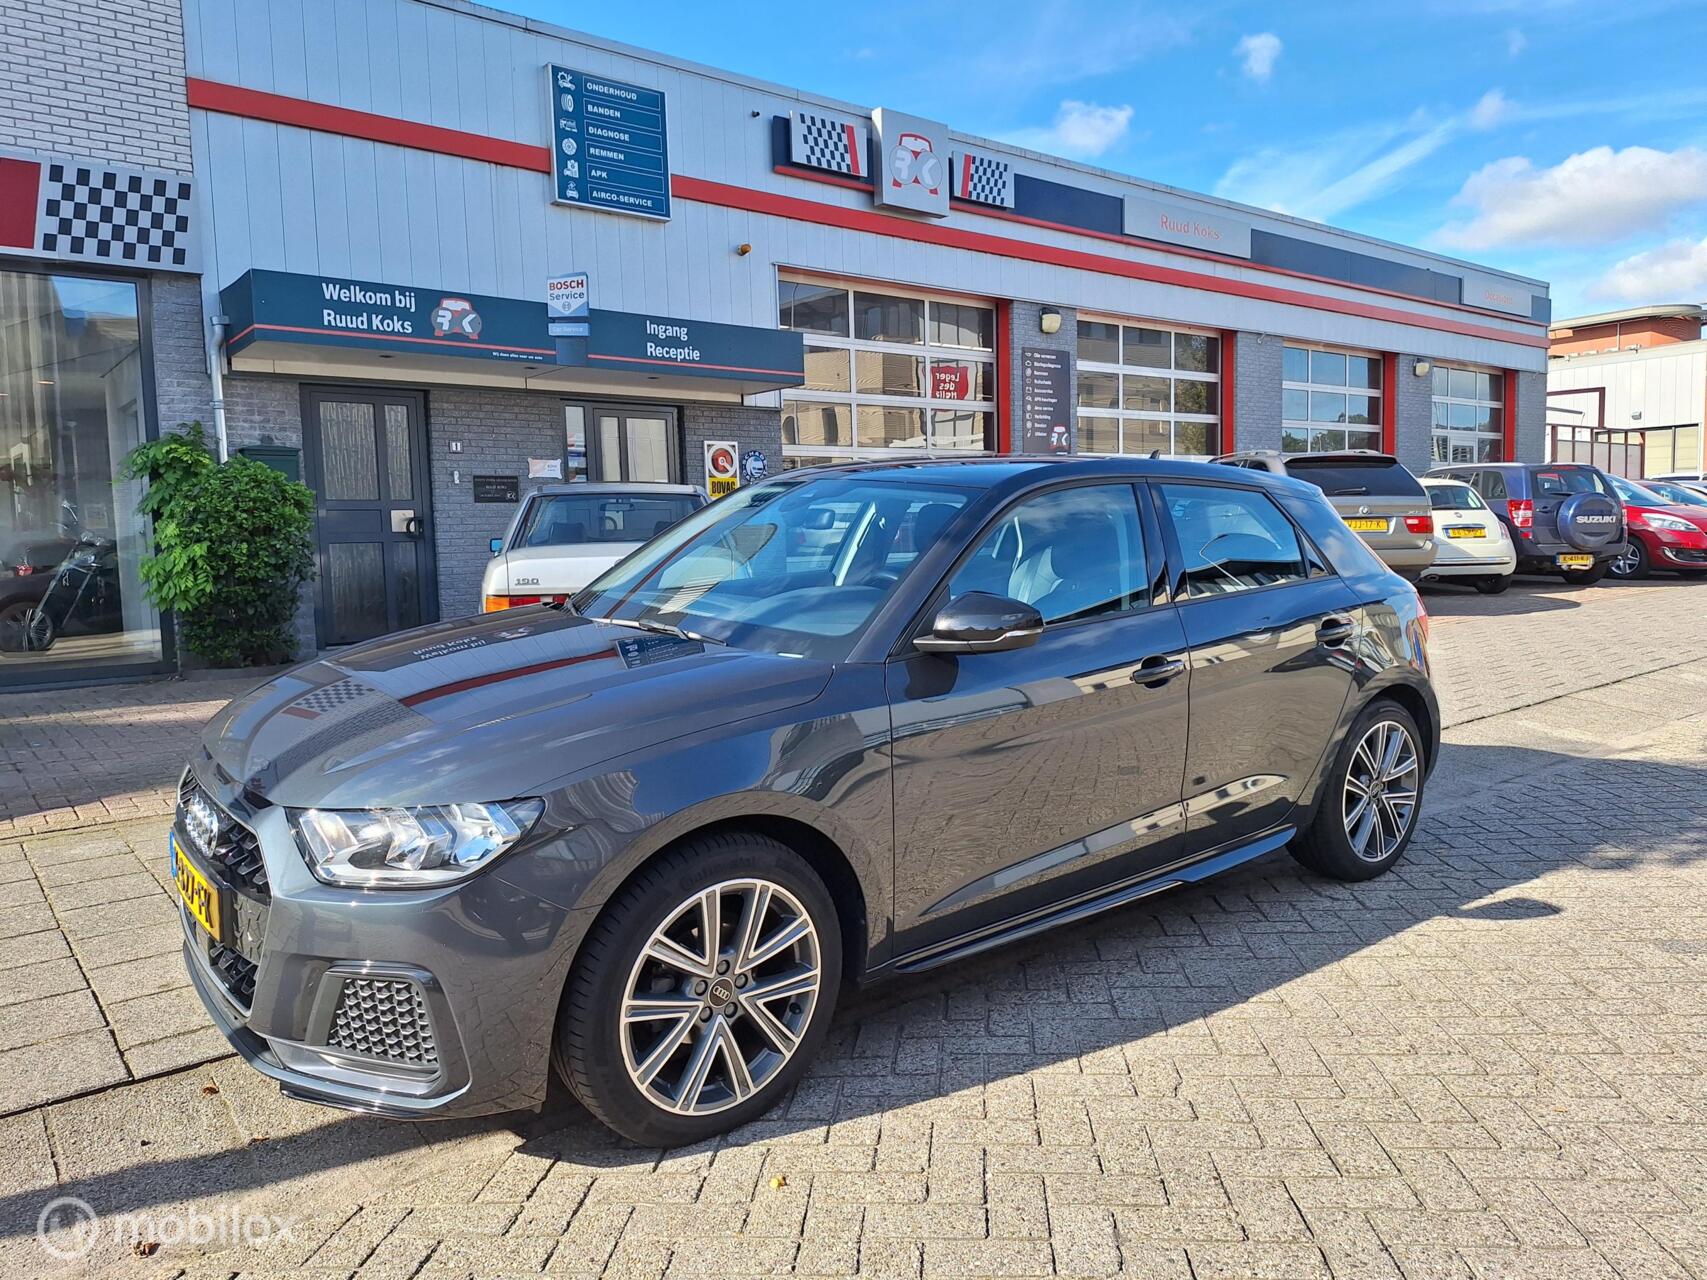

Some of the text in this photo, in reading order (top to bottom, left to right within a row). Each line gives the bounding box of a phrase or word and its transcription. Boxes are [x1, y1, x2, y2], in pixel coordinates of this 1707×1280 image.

[586, 82, 637, 100] ONDERHOUD
[587, 104, 621, 118] BANDEN
[588, 127, 630, 141] DIAGNOSE
[589, 147, 624, 161] REMMEN
[590, 169, 608, 179] APK
[592, 190, 652, 207] AIRCO-SERVICE
[1160, 213, 1220, 240] Ruud Koks
[549, 279, 584, 291] BOSCH
[321, 282, 416, 312] Welkom bij
[549, 290, 585, 301] Service
[322, 309, 413, 333] Ruud Koks
[646, 319, 688, 341] Ingang
[646, 342, 700, 362] Receptie
[1576, 515, 1617, 524] SUZUKI
[515, 577, 540, 586] 190
